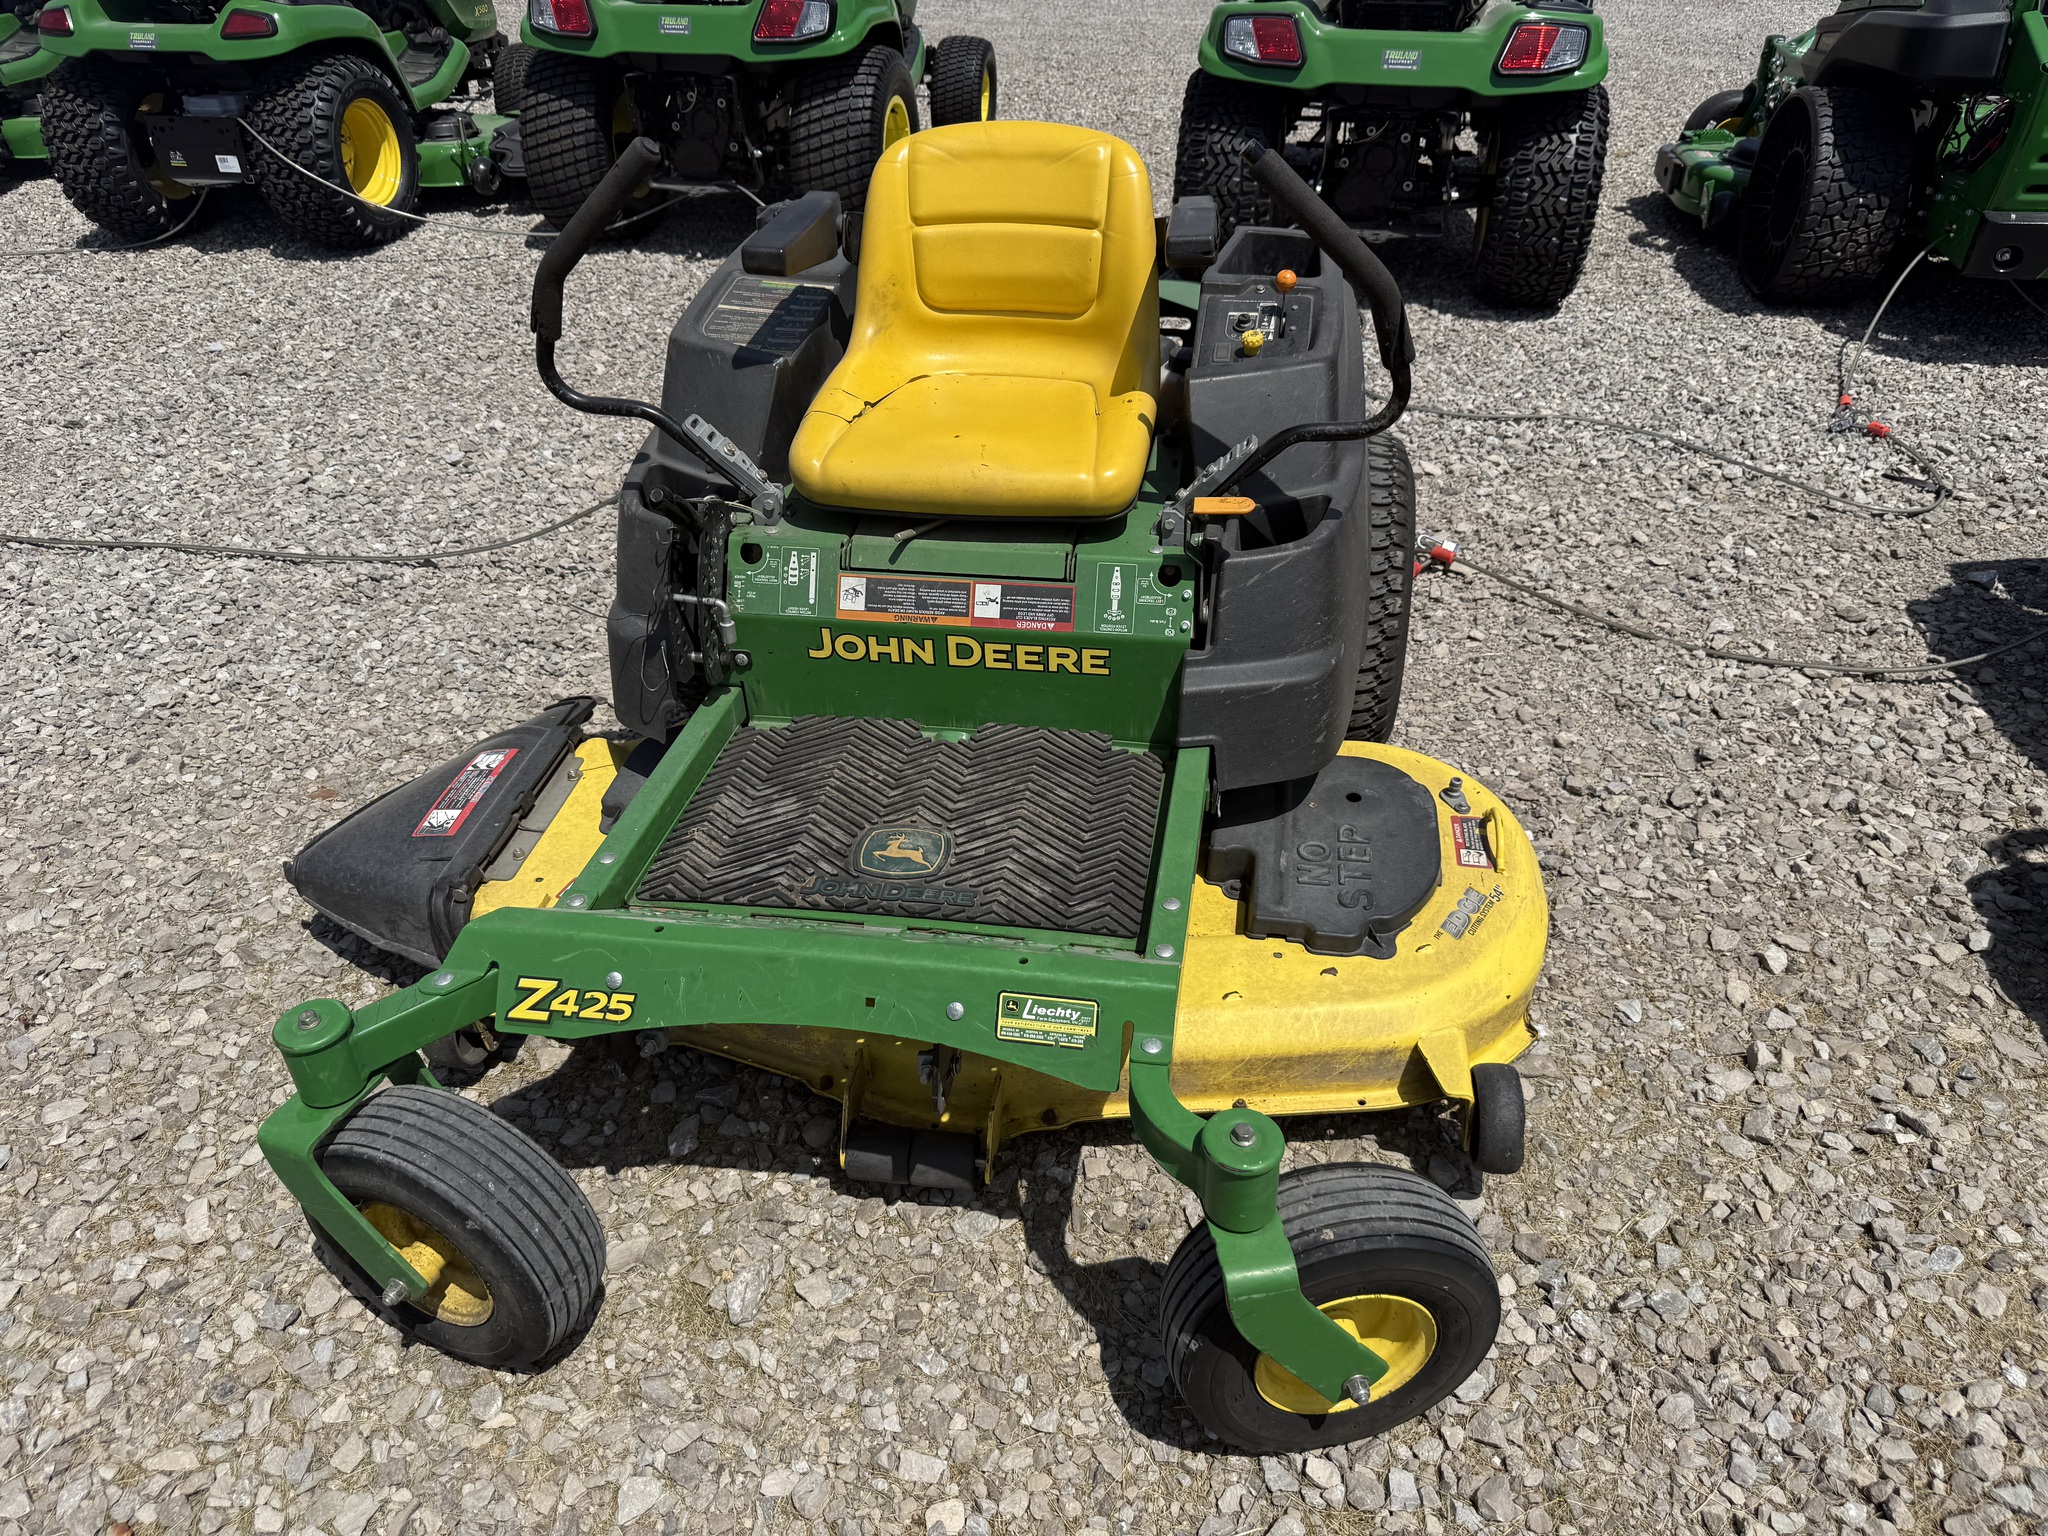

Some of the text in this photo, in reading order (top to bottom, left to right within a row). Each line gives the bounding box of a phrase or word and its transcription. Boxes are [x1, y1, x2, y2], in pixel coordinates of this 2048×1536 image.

[1386, 50, 1418, 60] TRULAND
[894, 614, 930, 623] WARNING
[1016, 621, 1047, 629] DANGER
[809, 627, 1110, 675] JOHN DEERE
[1296, 840, 1332, 887] NO
[1337, 824, 1374, 911] STEP
[801, 877, 977, 907] JOHN DEERE
[1468, 884, 1504, 936] CUTTING SYSTEM 54"
[1440, 886, 1488, 940] EDGE
[1434, 930, 1444, 940] THE
[507, 977, 637, 1023] Z425
[1022, 999, 1081, 1020] Liechty
